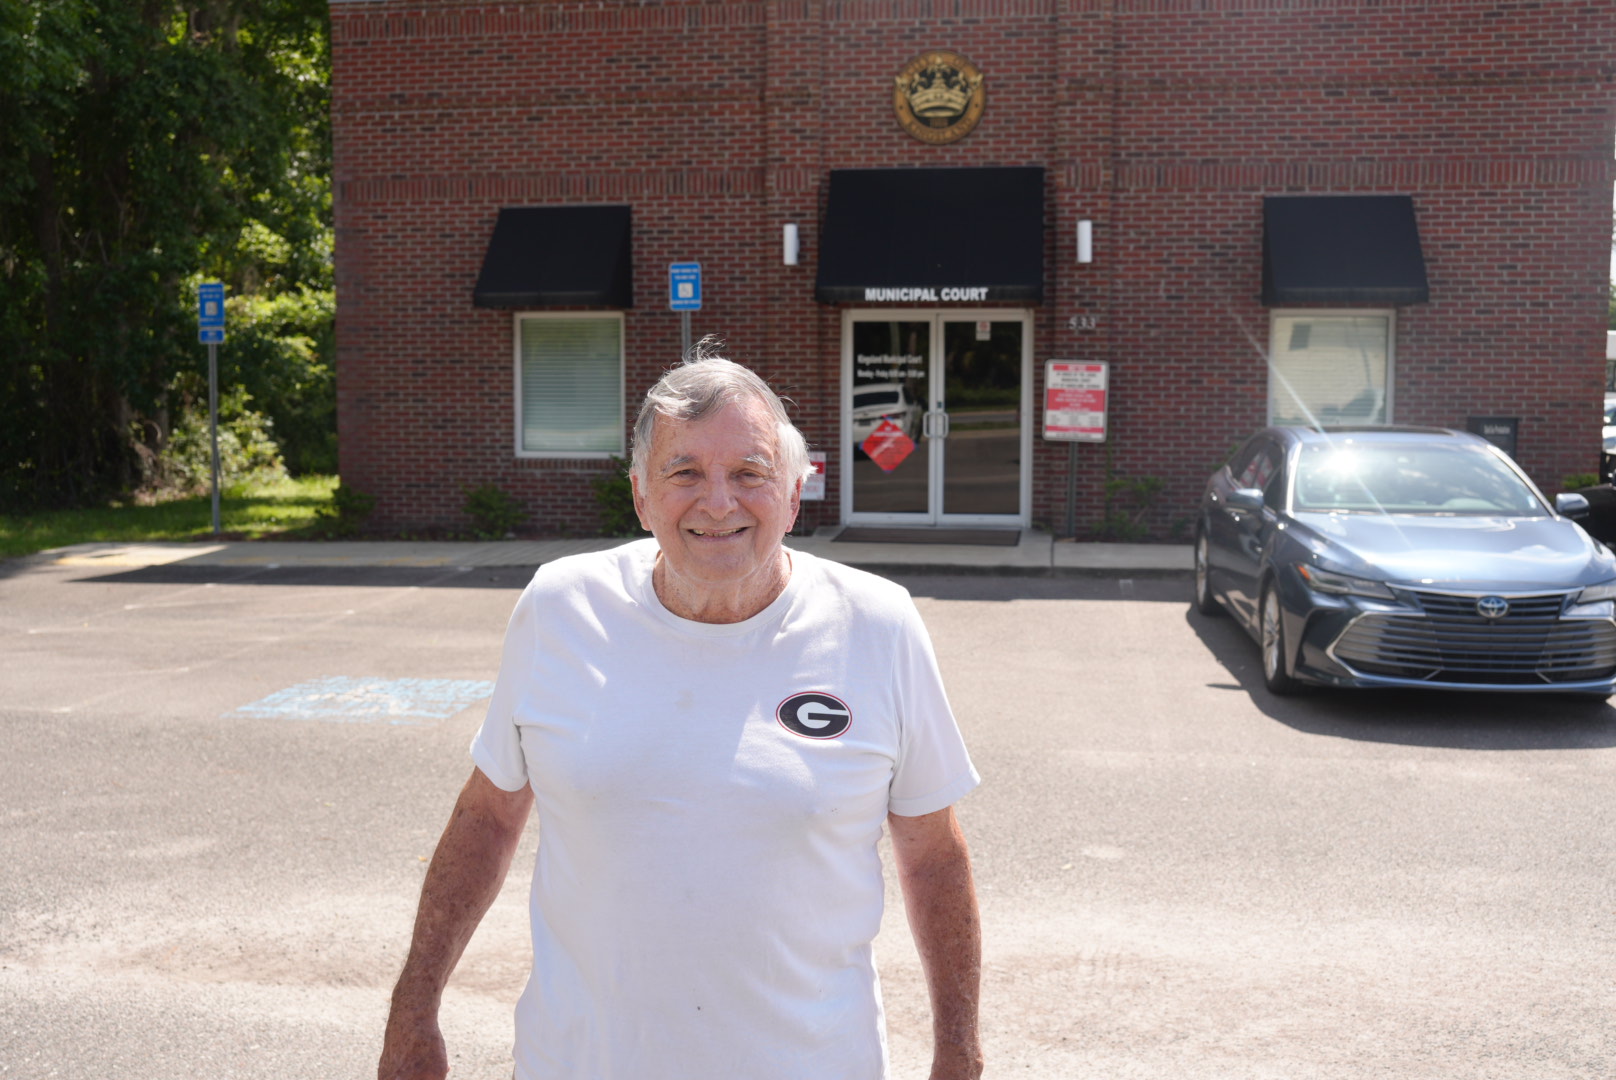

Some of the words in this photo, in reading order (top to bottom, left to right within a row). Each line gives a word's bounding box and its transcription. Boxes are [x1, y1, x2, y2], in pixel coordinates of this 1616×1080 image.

[864, 287, 939, 302] MUNICIPAL
[940, 287, 989, 301] COURT
[1068, 315, 1097, 330] 533
